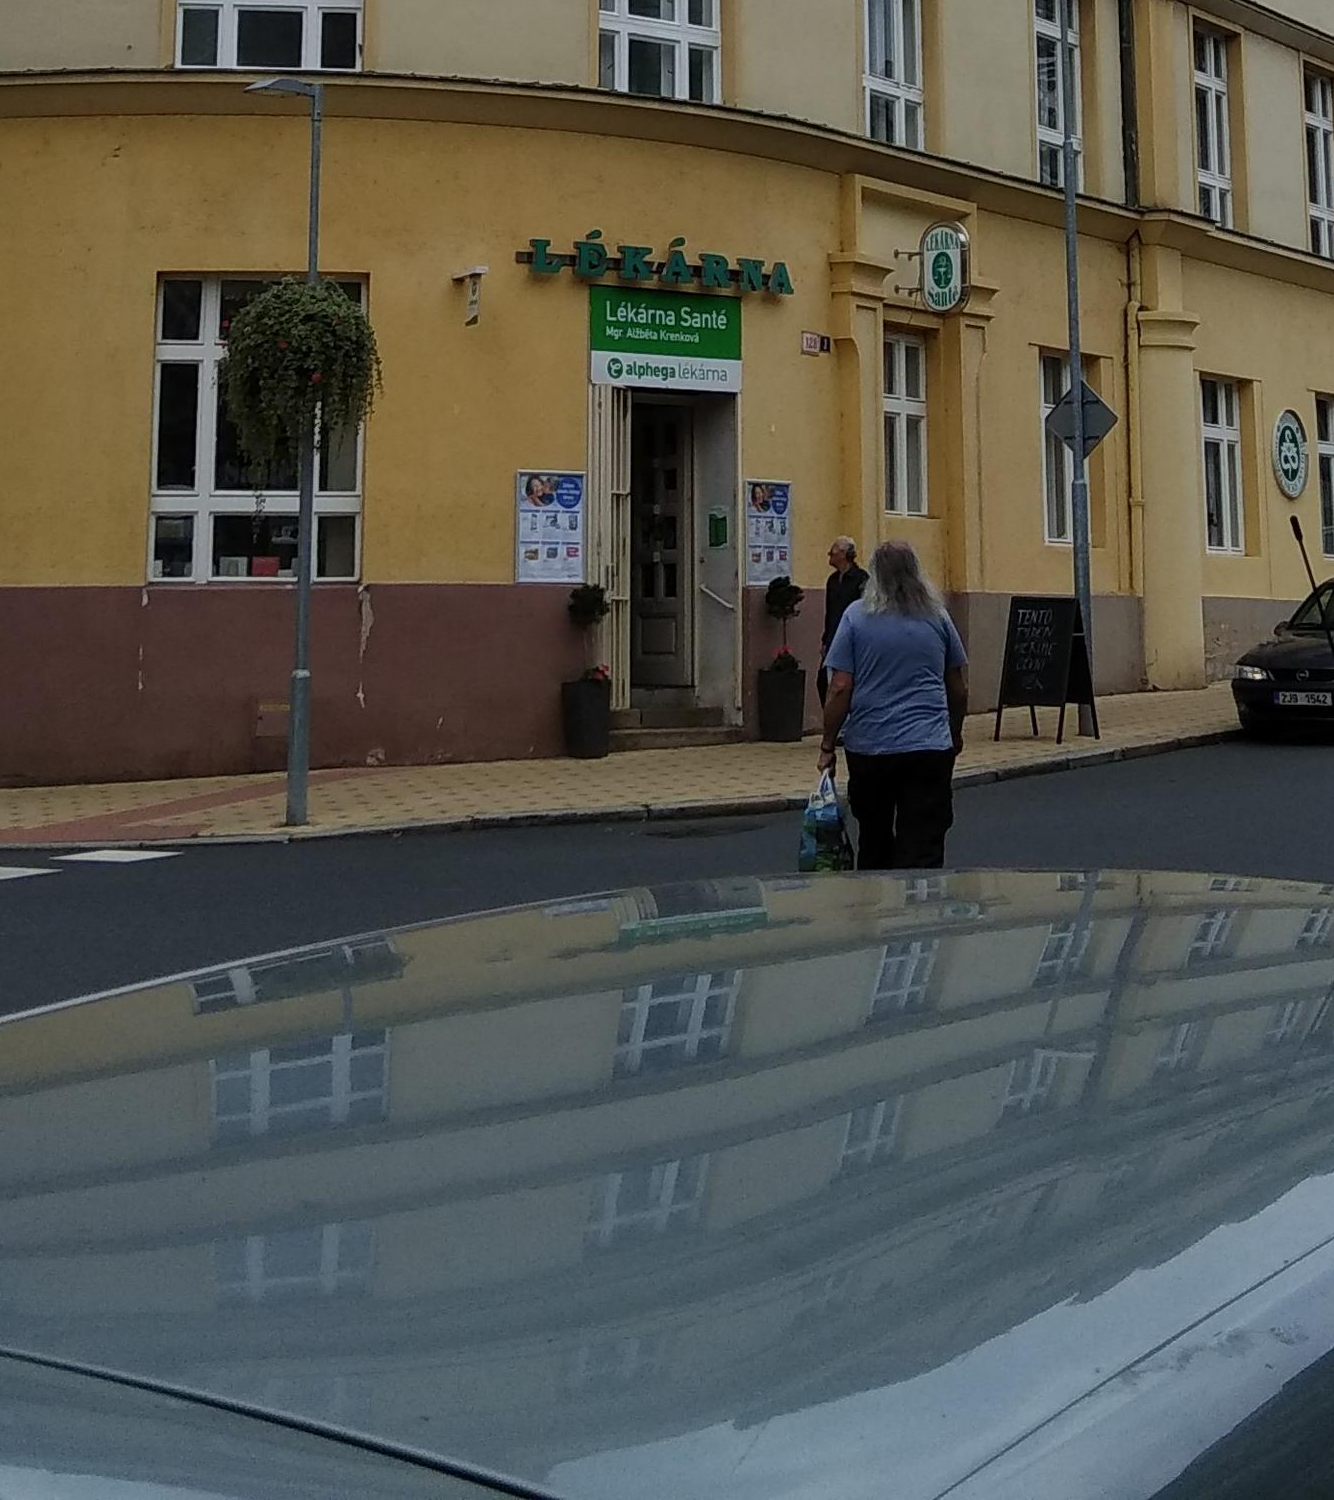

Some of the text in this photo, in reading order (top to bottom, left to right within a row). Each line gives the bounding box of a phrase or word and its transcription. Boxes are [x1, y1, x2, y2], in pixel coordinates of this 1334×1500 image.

[926, 230, 960, 252] LÉKÁRNA
[529, 229, 794, 295] LÉKÁRNA
[927, 285, 959, 307] Santé
[605, 300, 728, 330] Lékárna Santé
[626, 327, 658, 341] Alžběta
[660, 329, 700, 344] Krenková
[626, 361, 728, 382] alphega lékárna
[1017, 609, 1053, 625] TENTO
[1305, 693, 1328, 705] 1542
